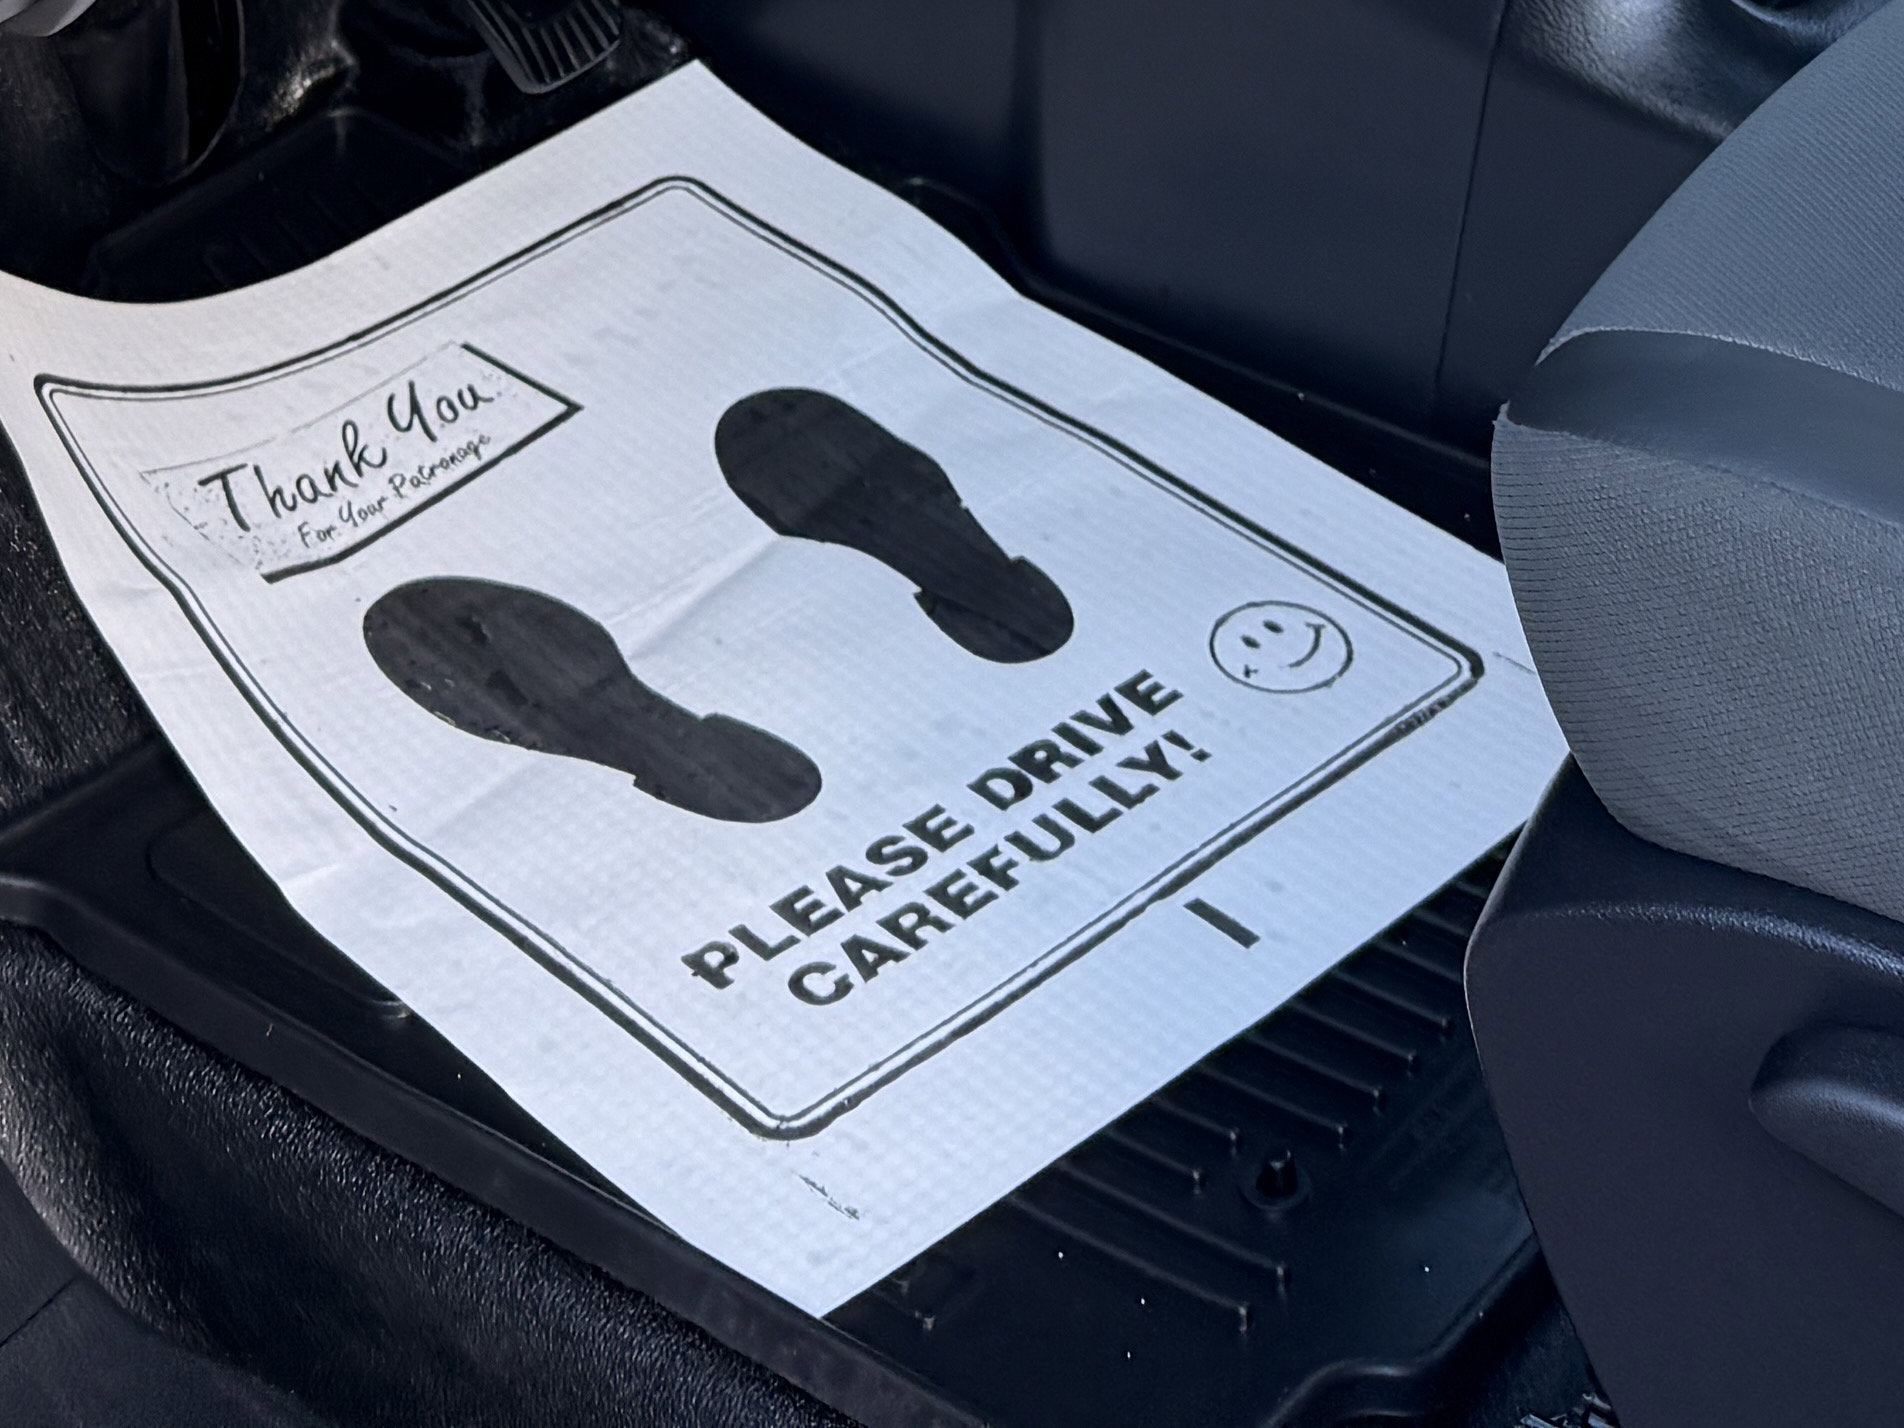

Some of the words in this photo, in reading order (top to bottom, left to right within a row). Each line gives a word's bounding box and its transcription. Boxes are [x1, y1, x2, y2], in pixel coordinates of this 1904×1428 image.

[198, 420, 387, 532] Thank
[386, 380, 495, 442] You
[297, 523, 336, 548] For
[338, 496, 387, 527] Your
[387, 432, 492, 499] Patronage
[681, 803, 975, 990] PLEASE
[967, 669, 1184, 811] DRIVE
[787, 730, 1213, 1006] CAREFULLY!
